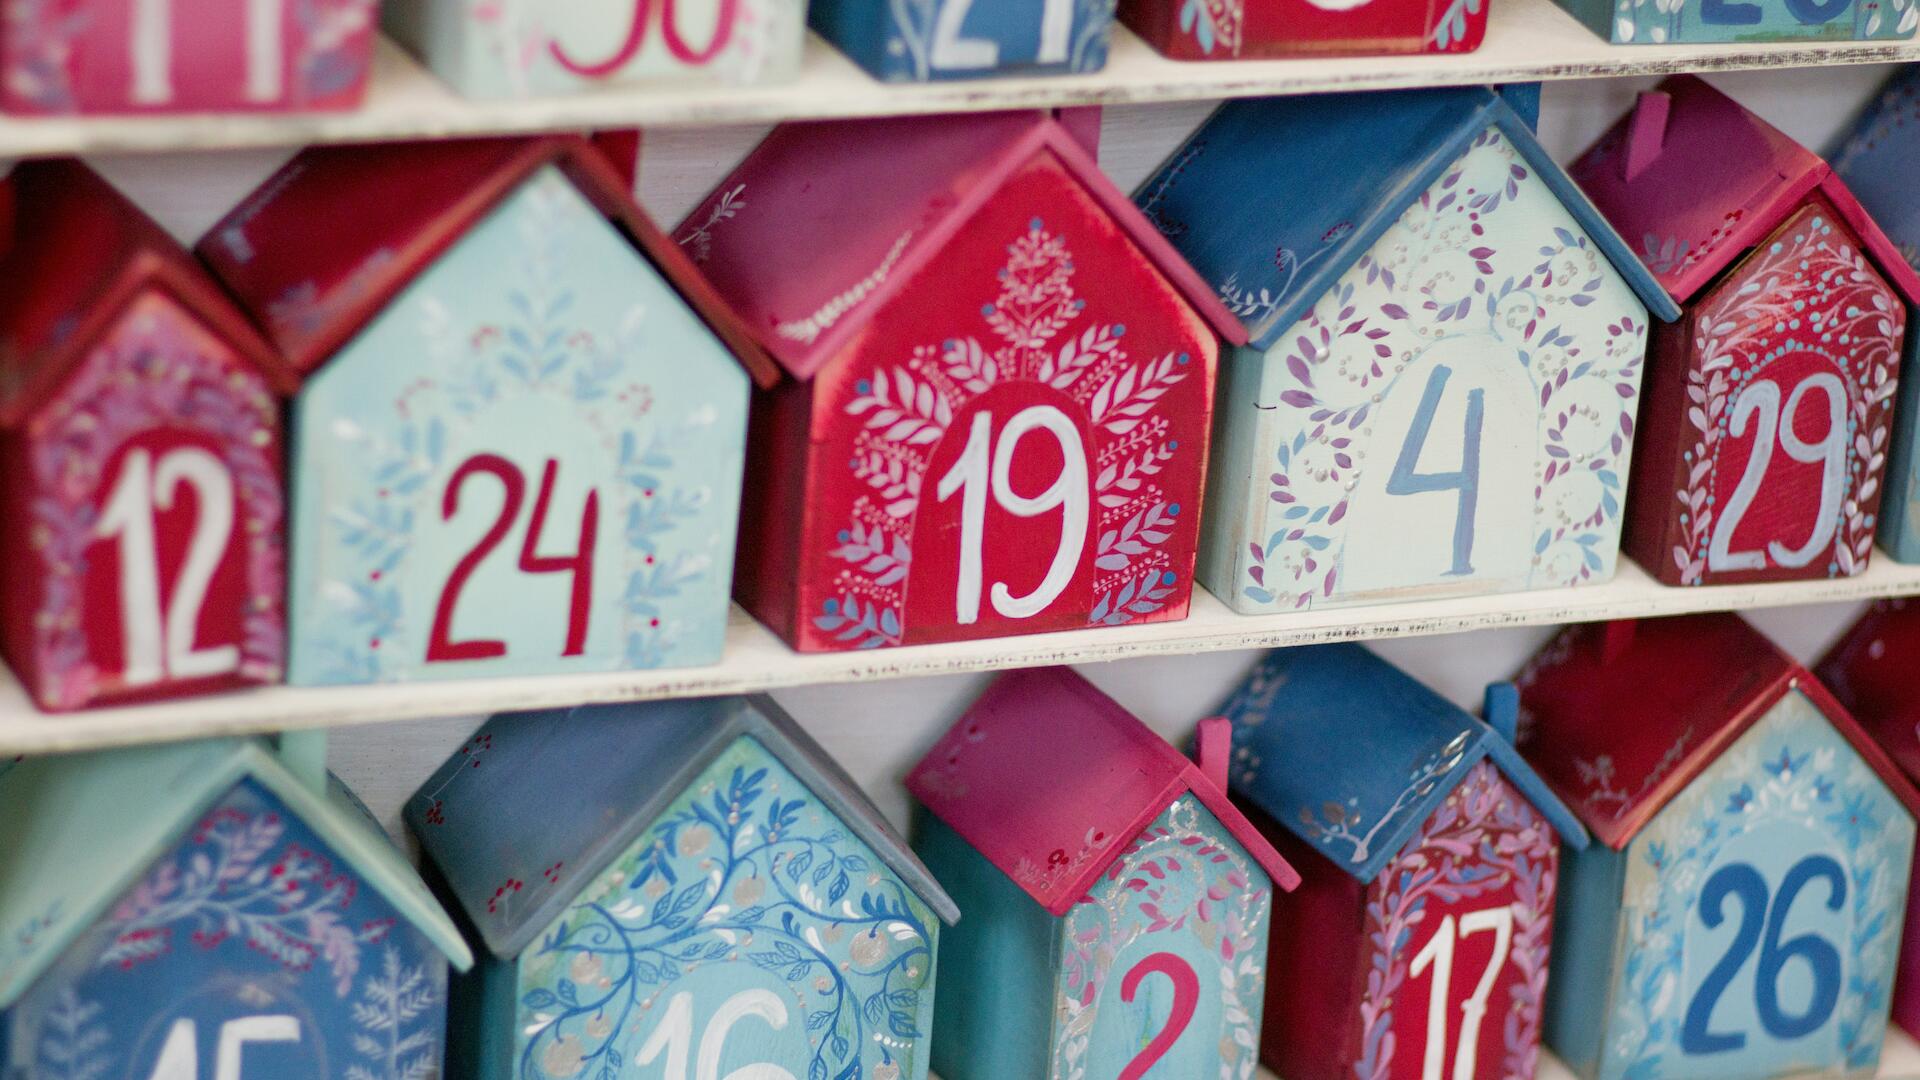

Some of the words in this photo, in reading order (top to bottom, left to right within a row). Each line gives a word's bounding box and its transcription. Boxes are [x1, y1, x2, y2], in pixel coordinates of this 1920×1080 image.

[93, 447, 240, 684] 12
[425, 453, 599, 663] 24
[938, 405, 1090, 624] 19
[1386, 364, 1484, 576] 4
[1708, 372, 1848, 572] 29
[1117, 952, 1200, 1080] 2
[1411, 906, 1513, 1080] 17
[1680, 855, 1847, 1054] 26
